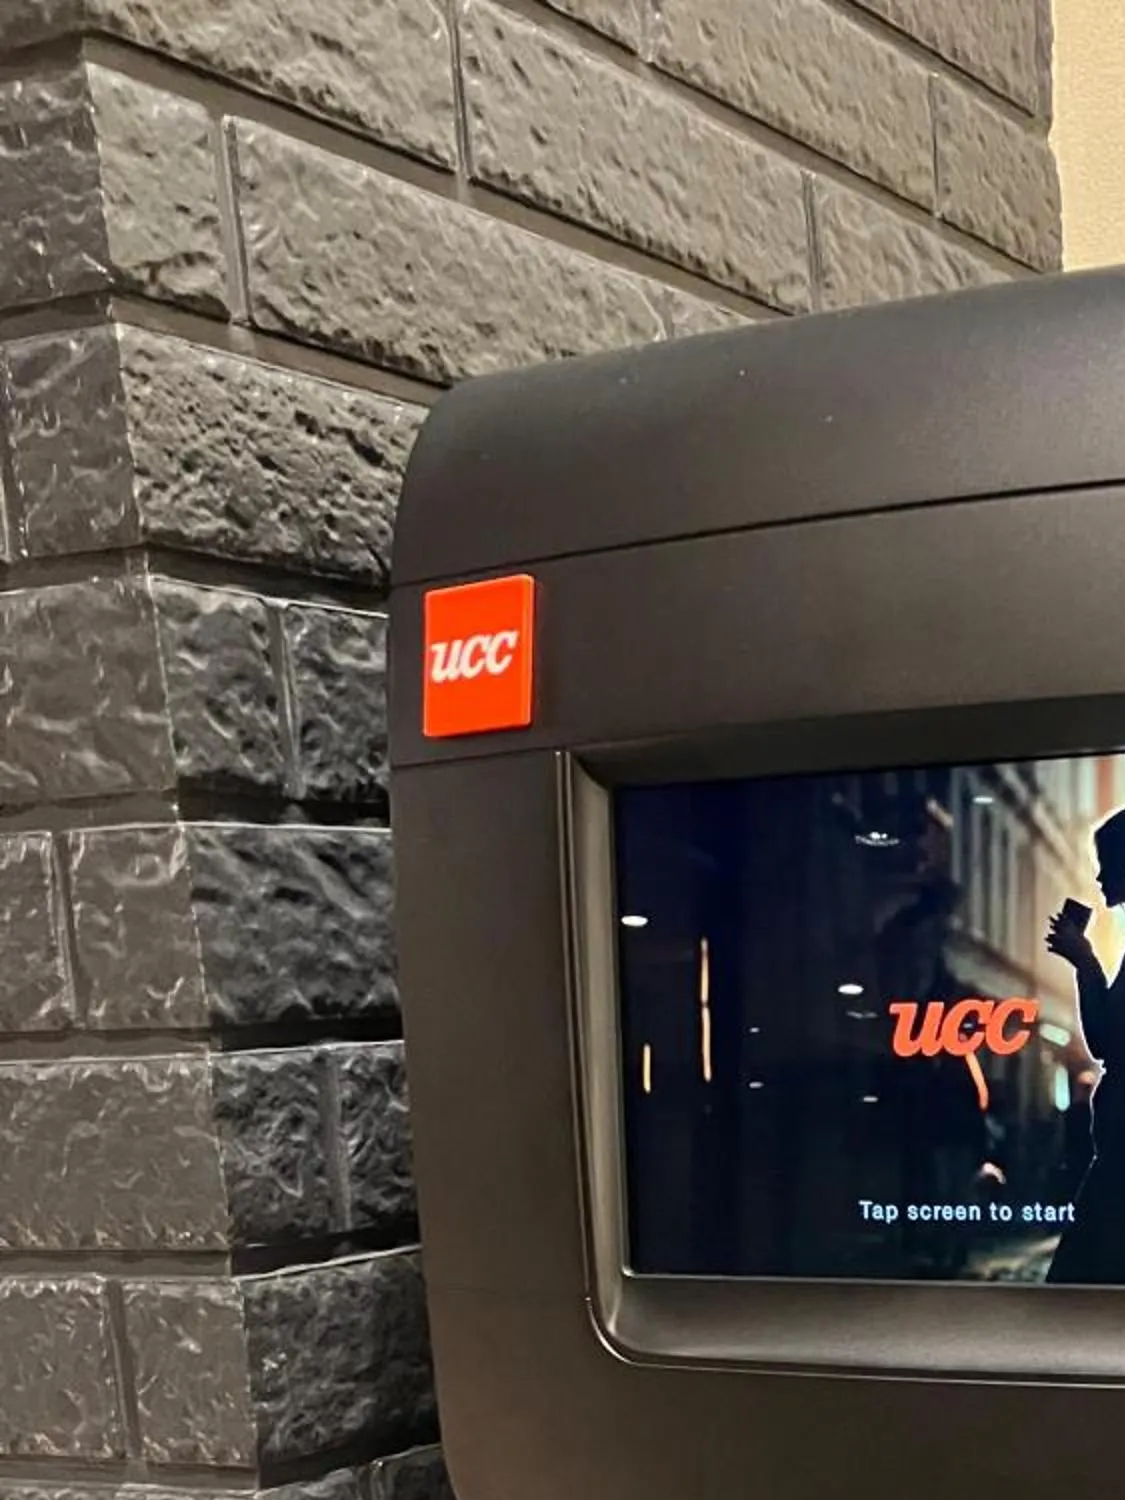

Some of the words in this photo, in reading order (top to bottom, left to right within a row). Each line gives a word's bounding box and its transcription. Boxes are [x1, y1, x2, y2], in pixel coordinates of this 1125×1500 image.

[858, 1200, 899, 1224] Tap
[907, 1203, 981, 1221] screen
[989, 1202, 1013, 1221] to
[1021, 1202, 1075, 1222] start
